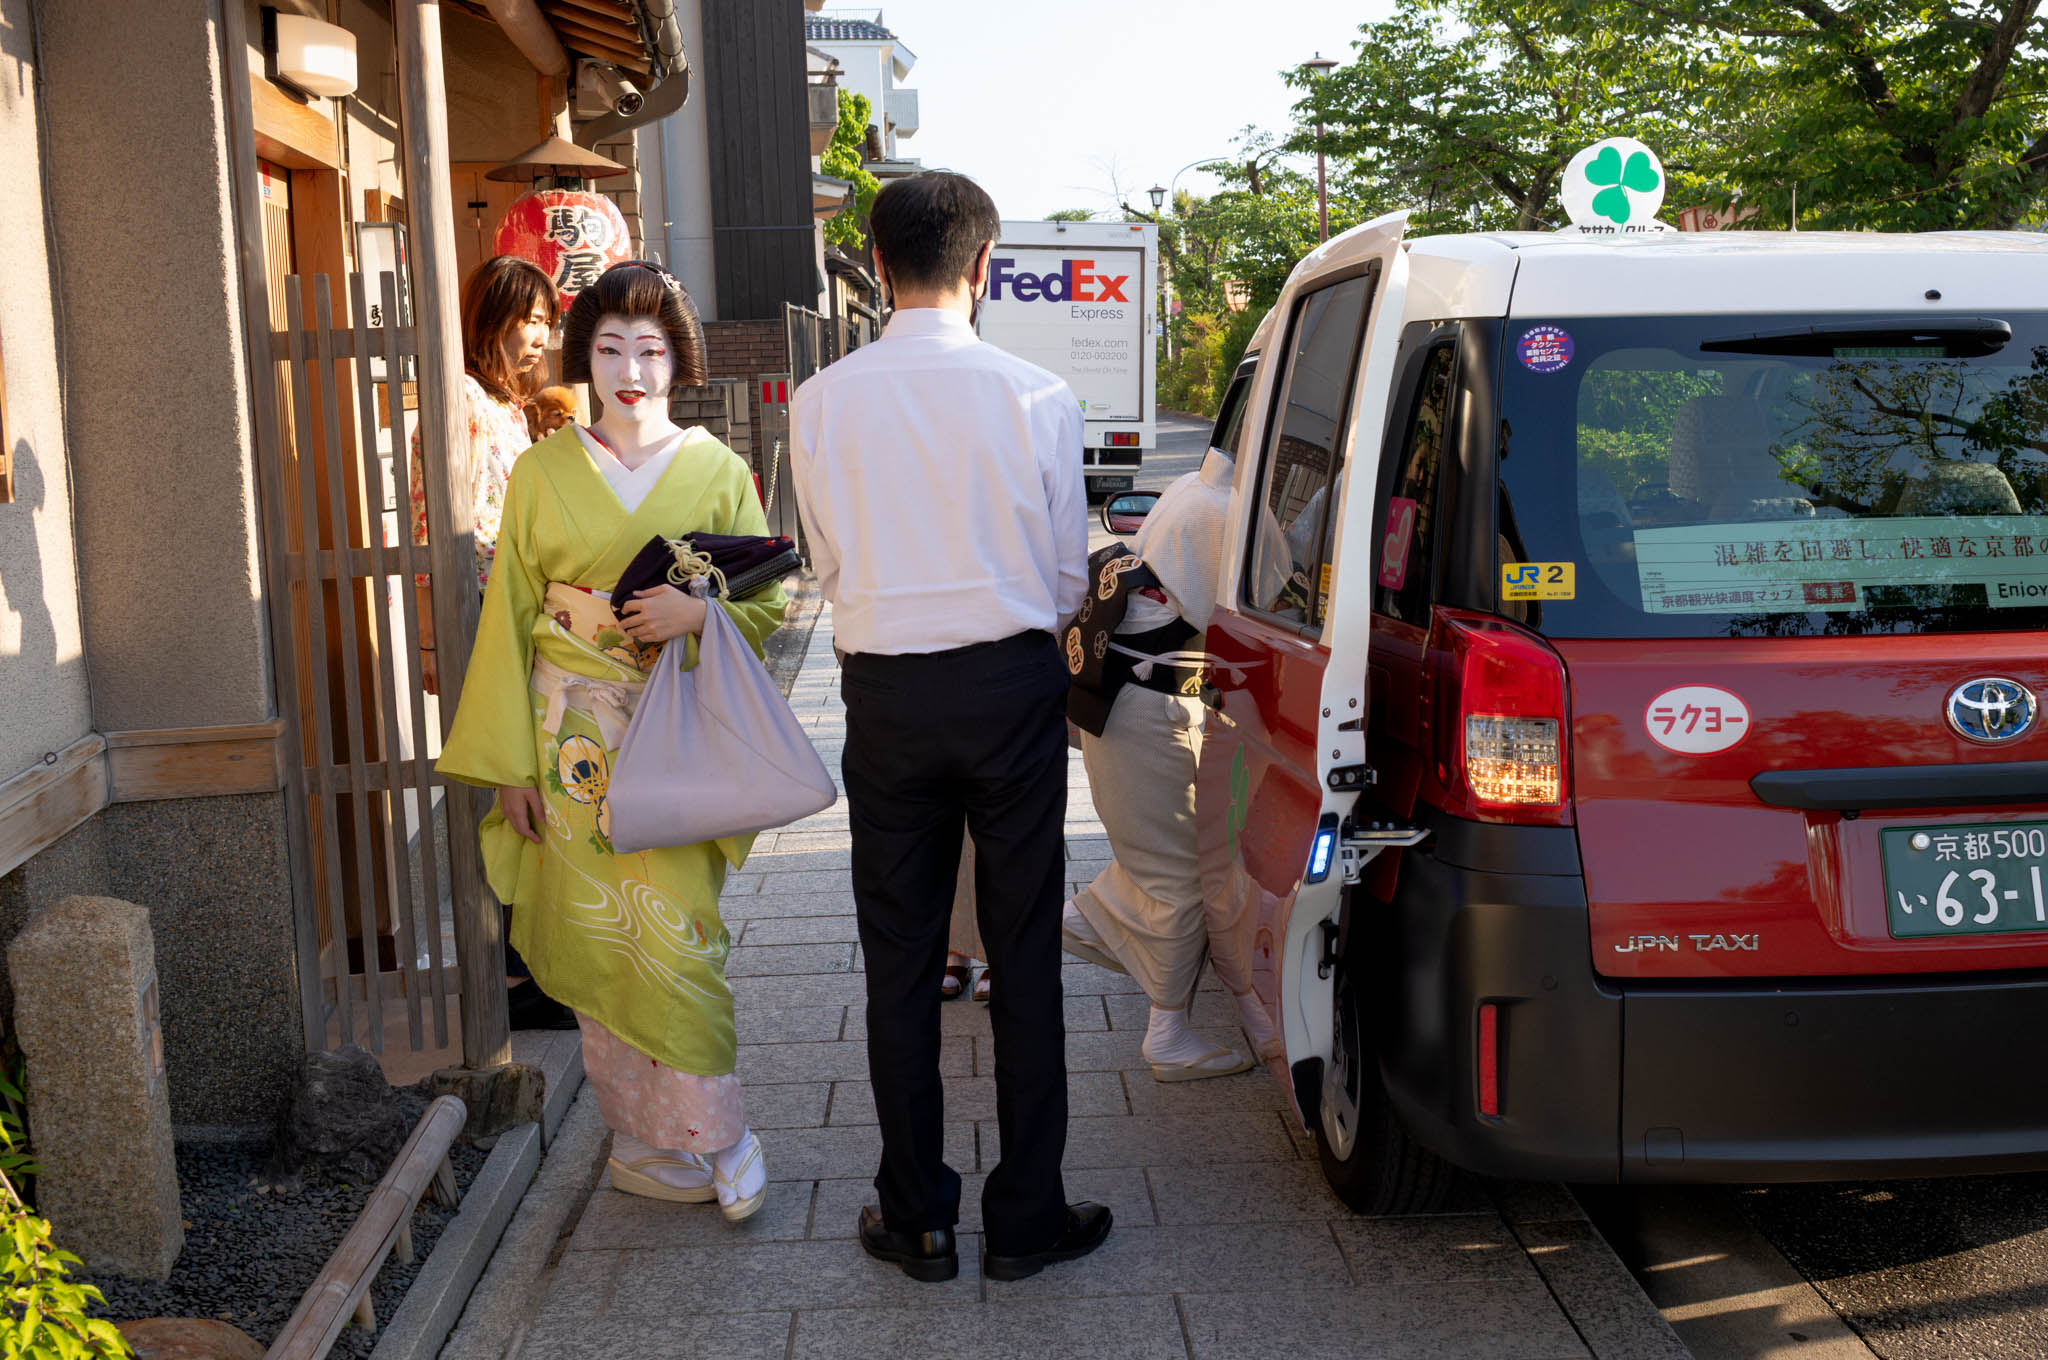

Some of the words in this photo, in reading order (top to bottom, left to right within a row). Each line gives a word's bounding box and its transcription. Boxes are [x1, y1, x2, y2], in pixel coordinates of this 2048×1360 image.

[547, 206, 608, 292] 駒屋
[990, 258, 1129, 303] FedEx
[1071, 305, 1124, 321] Express
[1071, 336, 1128, 349] fedex.com
[1070, 351, 1128, 361] 0120-003200
[1506, 566, 1540, 584] JR
[1547, 566, 1564, 583] 2
[1662, 589, 1793, 609] 京都観光快適度マップ
[1652, 704, 1744, 735] ラクヨー
[1897, 890, 1928, 914] い
[1614, 935, 1679, 952] JPN
[1687, 934, 1759, 951] TAXI
